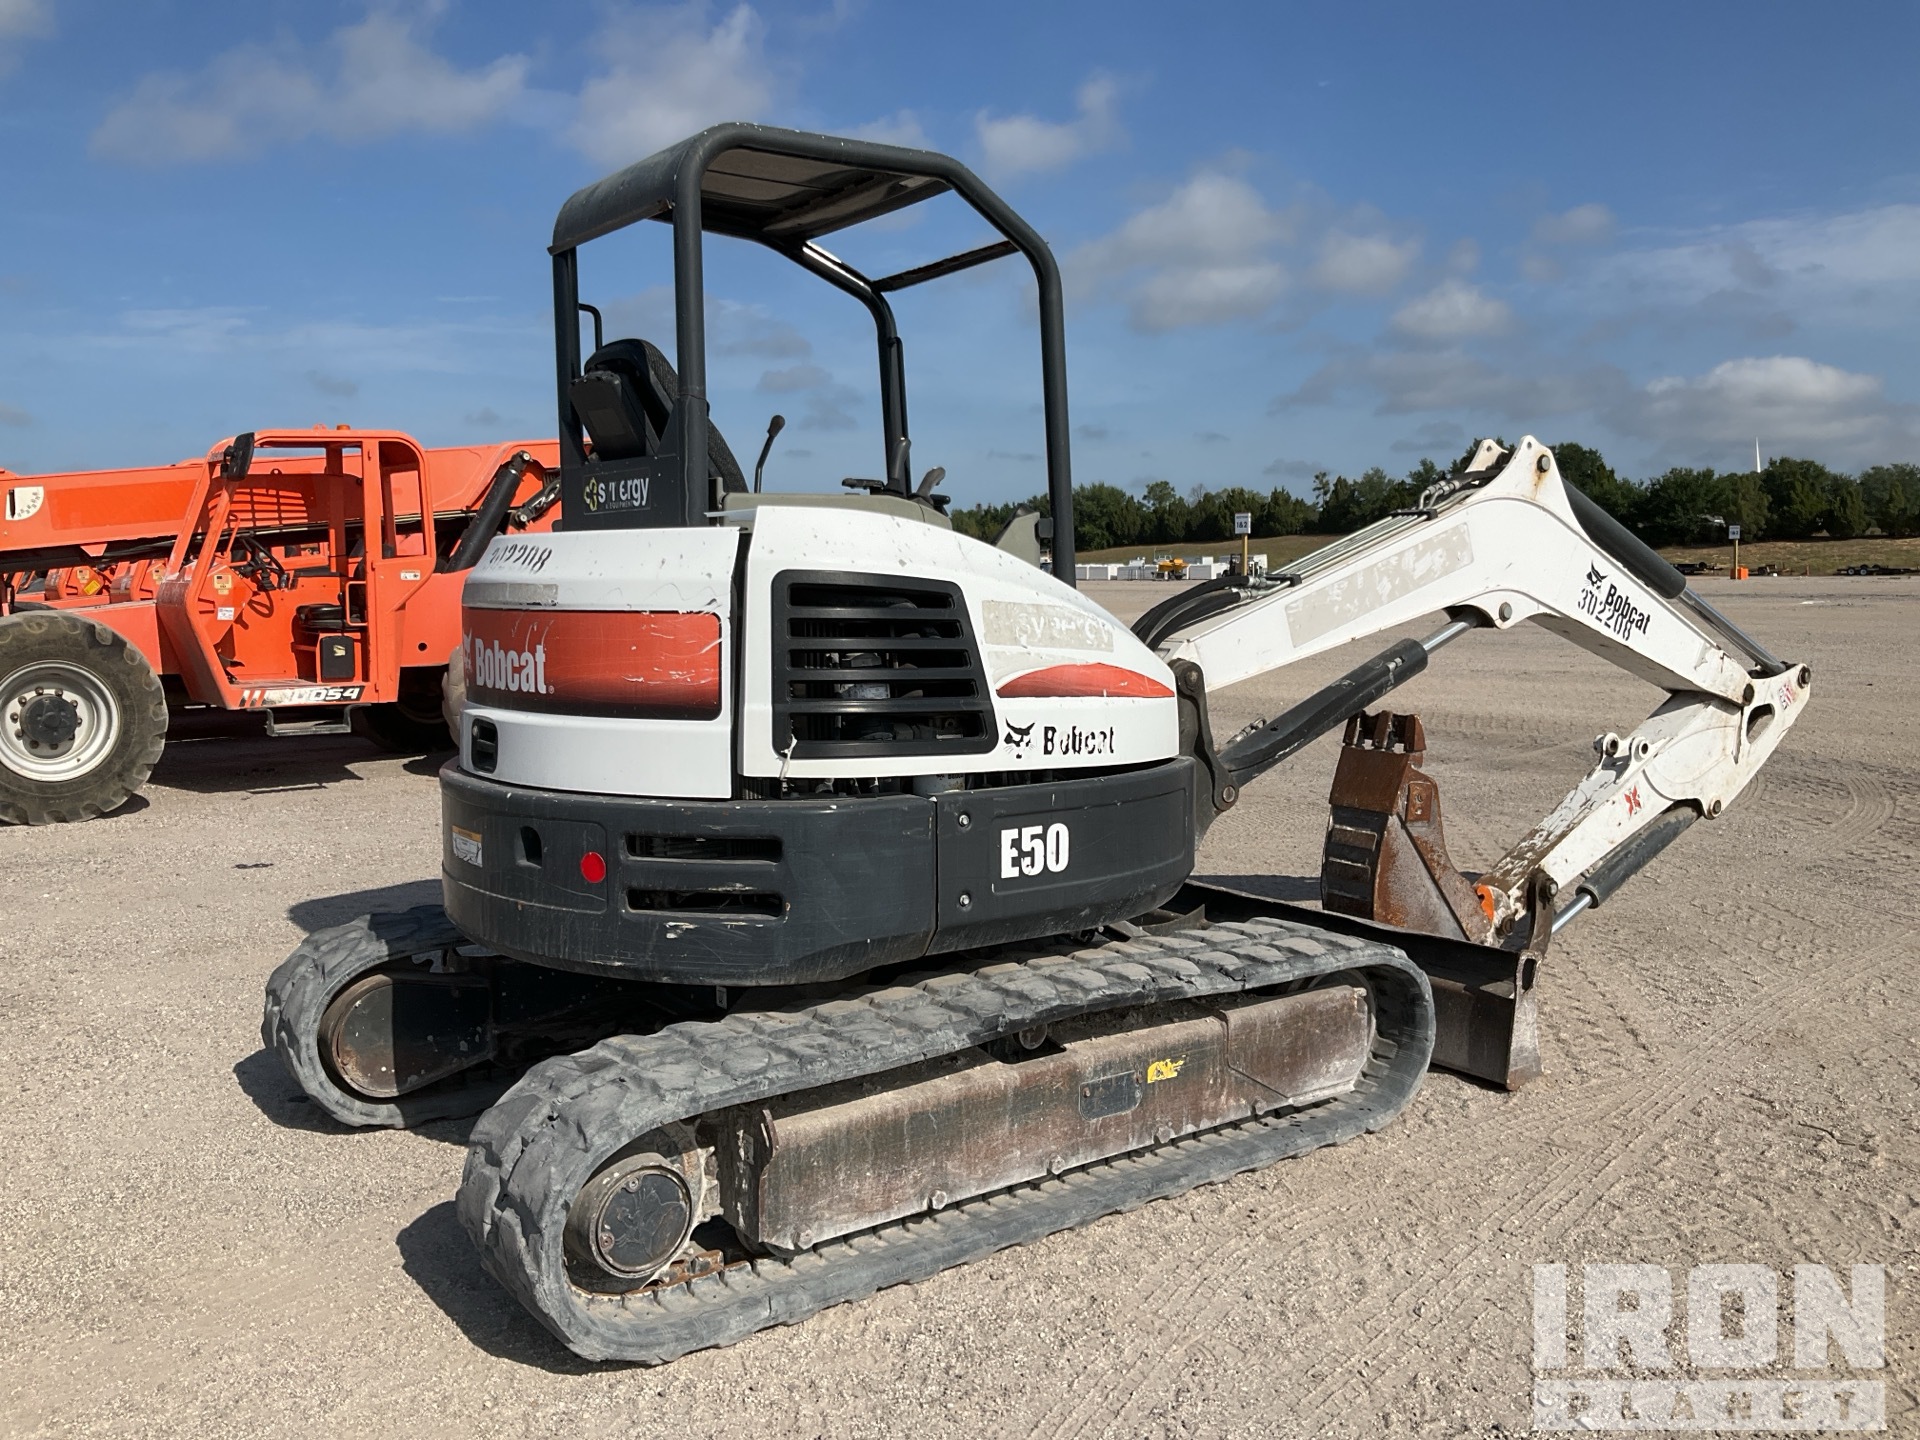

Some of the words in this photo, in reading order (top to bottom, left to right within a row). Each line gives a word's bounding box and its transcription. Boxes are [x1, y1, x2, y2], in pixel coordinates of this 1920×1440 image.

[1605, 583, 1651, 635] Bobcat
[475, 637, 547, 694] Bobcat
[1001, 822, 1069, 878] E50
